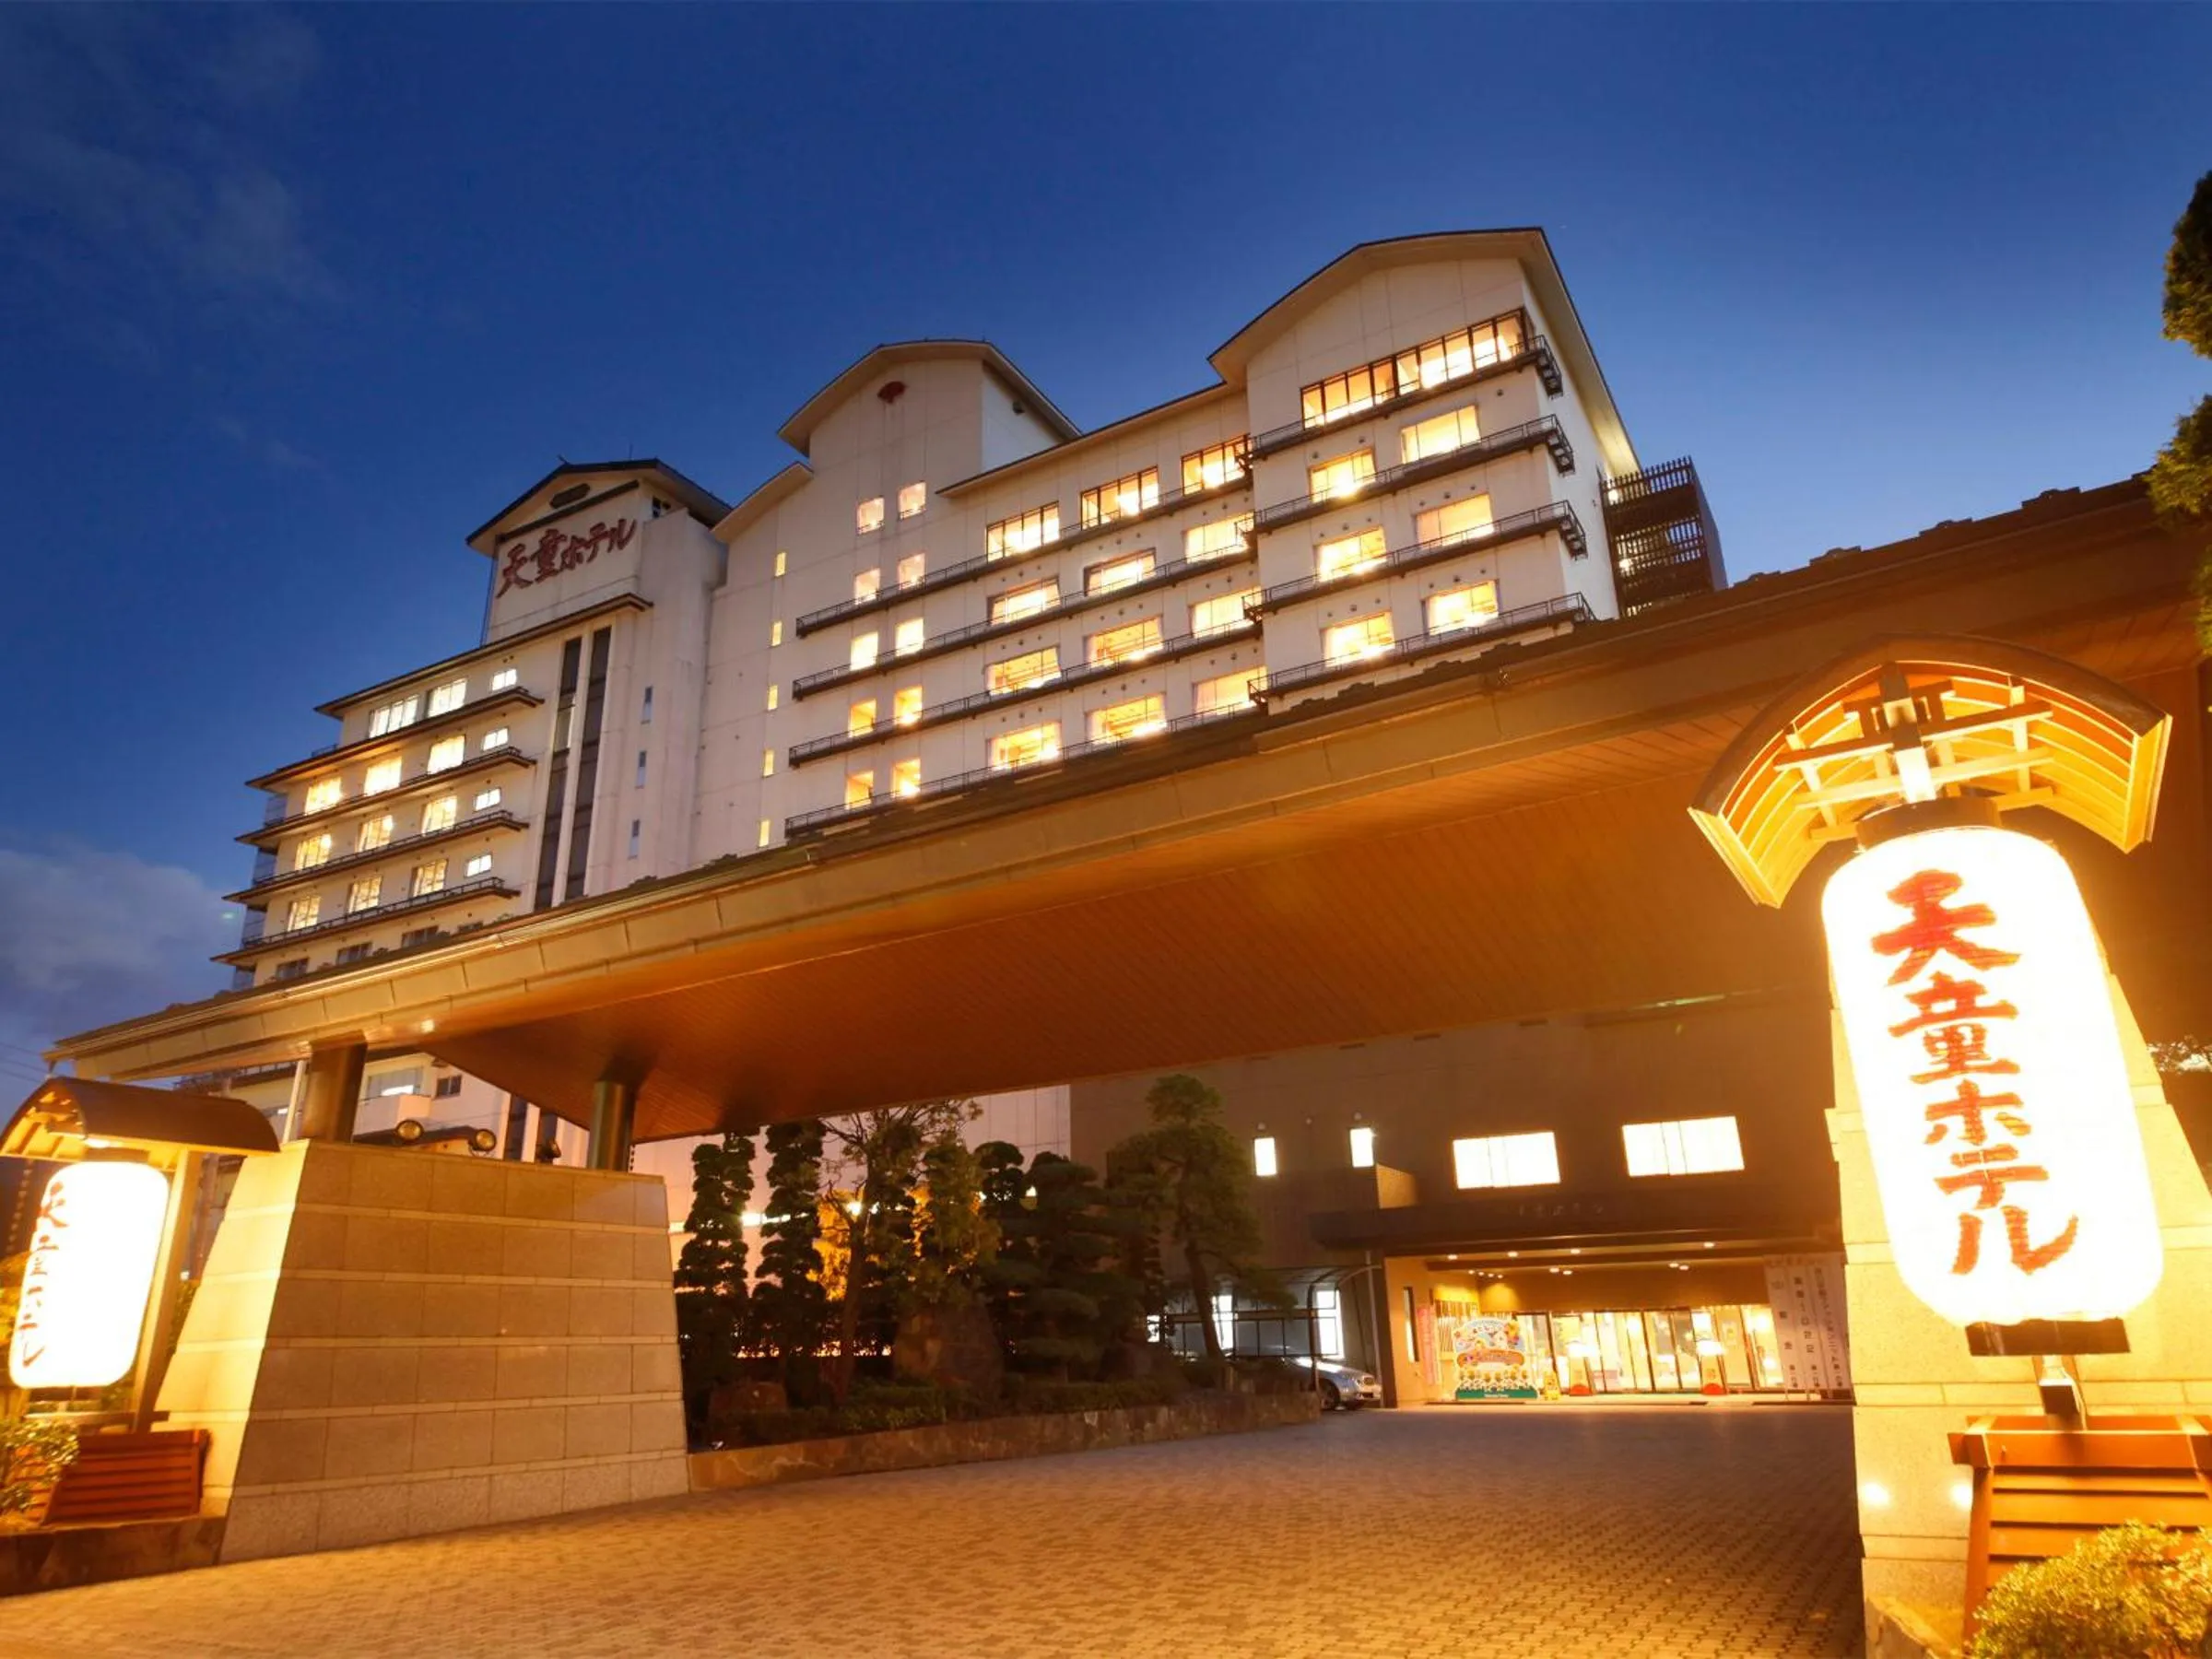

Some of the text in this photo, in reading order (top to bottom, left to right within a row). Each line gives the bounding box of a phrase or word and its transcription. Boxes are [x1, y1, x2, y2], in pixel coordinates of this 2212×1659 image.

[496, 518, 637, 598] 天童ホテル
[1871, 869, 2079, 1276] 天童ホテル
